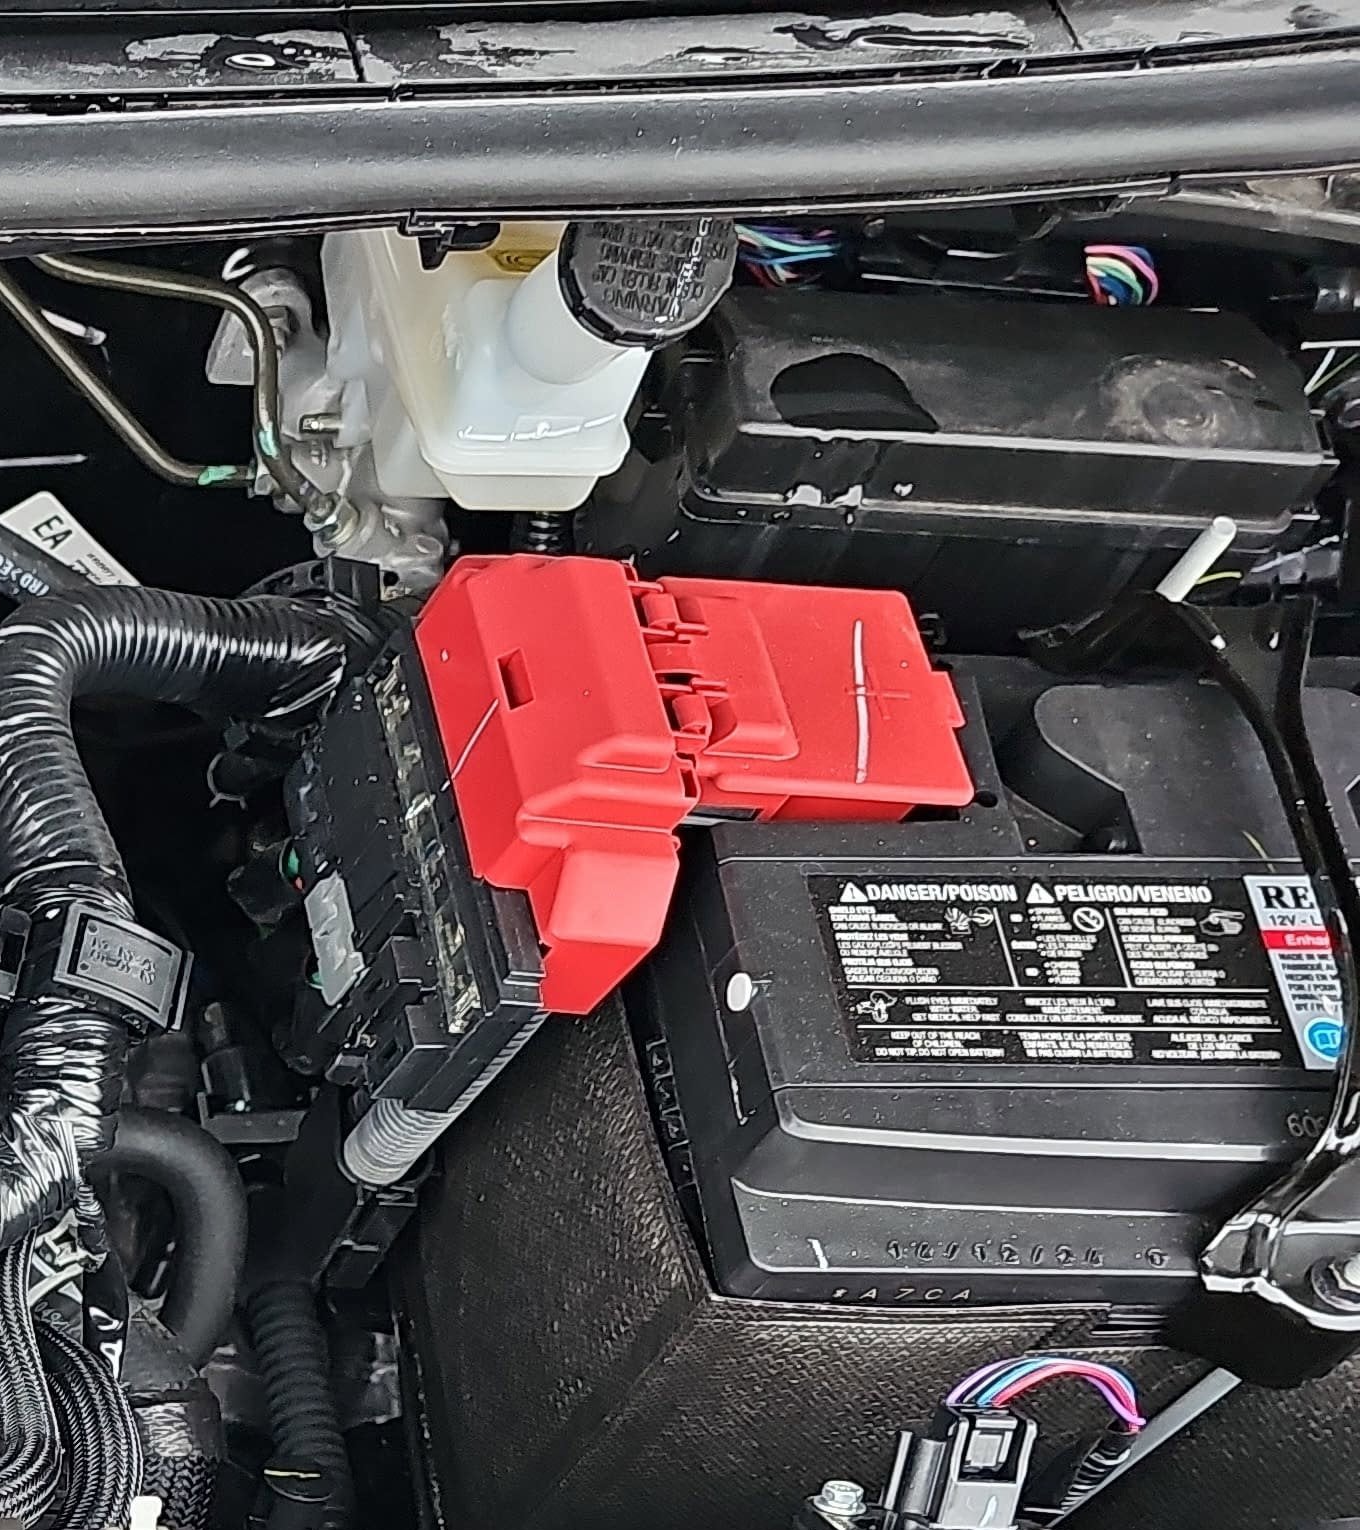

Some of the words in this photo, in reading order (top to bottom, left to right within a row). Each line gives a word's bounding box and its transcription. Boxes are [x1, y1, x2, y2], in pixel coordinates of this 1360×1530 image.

[31, 514, 73, 550] EA
[865, 883, 1019, 902] DANGER/POISON
[1053, 884, 1213, 903] PELIGRO/VENENO
[1268, 913, 1296, 927] 12V
